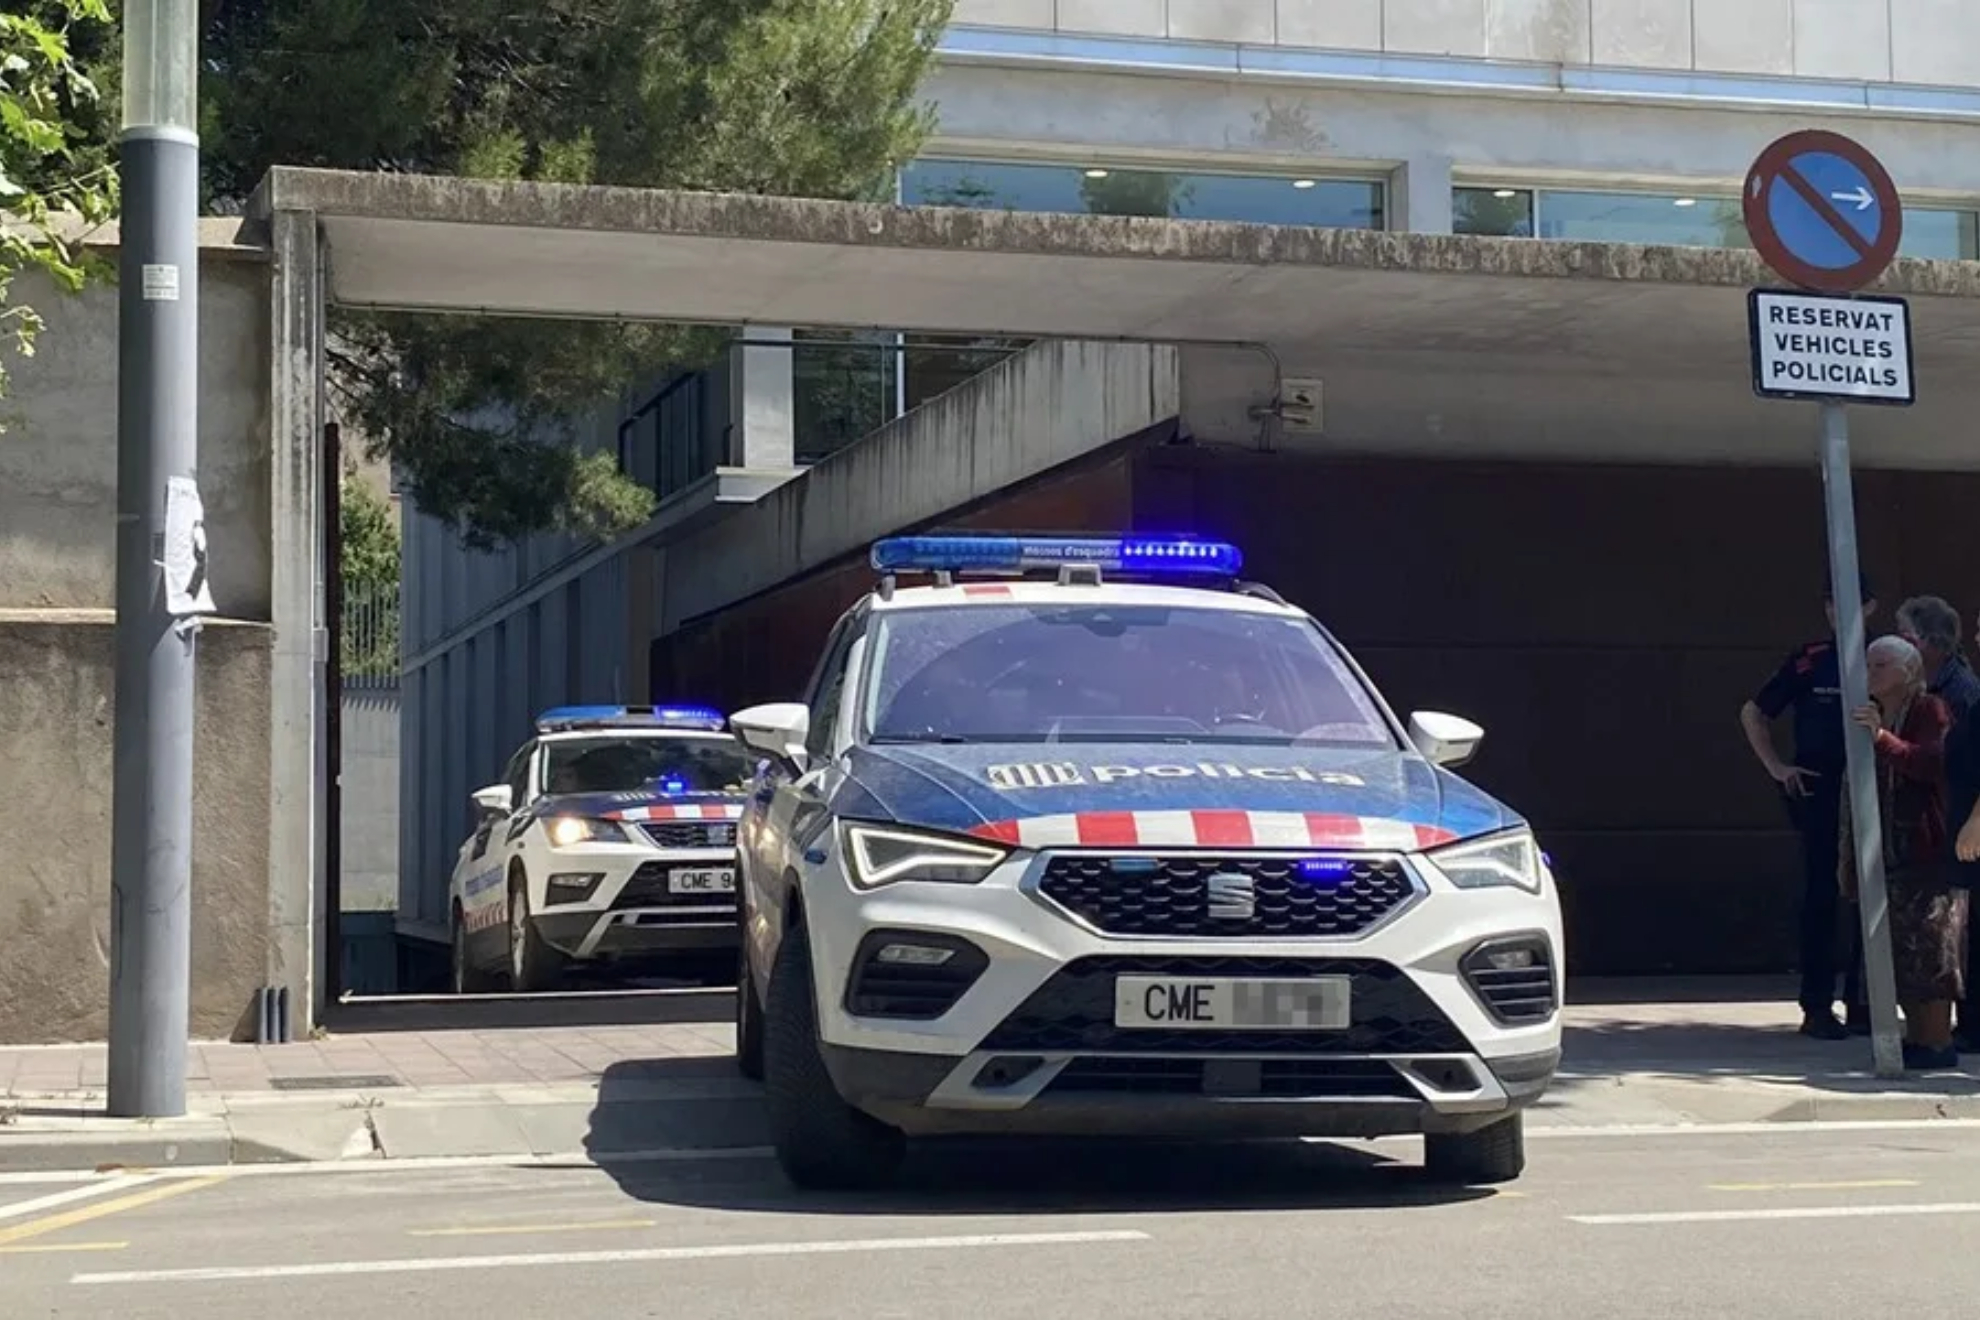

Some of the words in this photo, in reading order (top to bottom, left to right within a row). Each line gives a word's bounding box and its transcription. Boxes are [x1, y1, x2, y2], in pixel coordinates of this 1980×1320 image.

[1769, 305, 1893, 332] RESERVAT
[1774, 333, 1893, 358] VEHICLES
[1772, 360, 1898, 387] POLICIALS
[1091, 762, 1365, 786] policia
[681, 872, 713, 889] CME
[721, 872, 735, 889] 9
[1144, 984, 1215, 1021] CME
